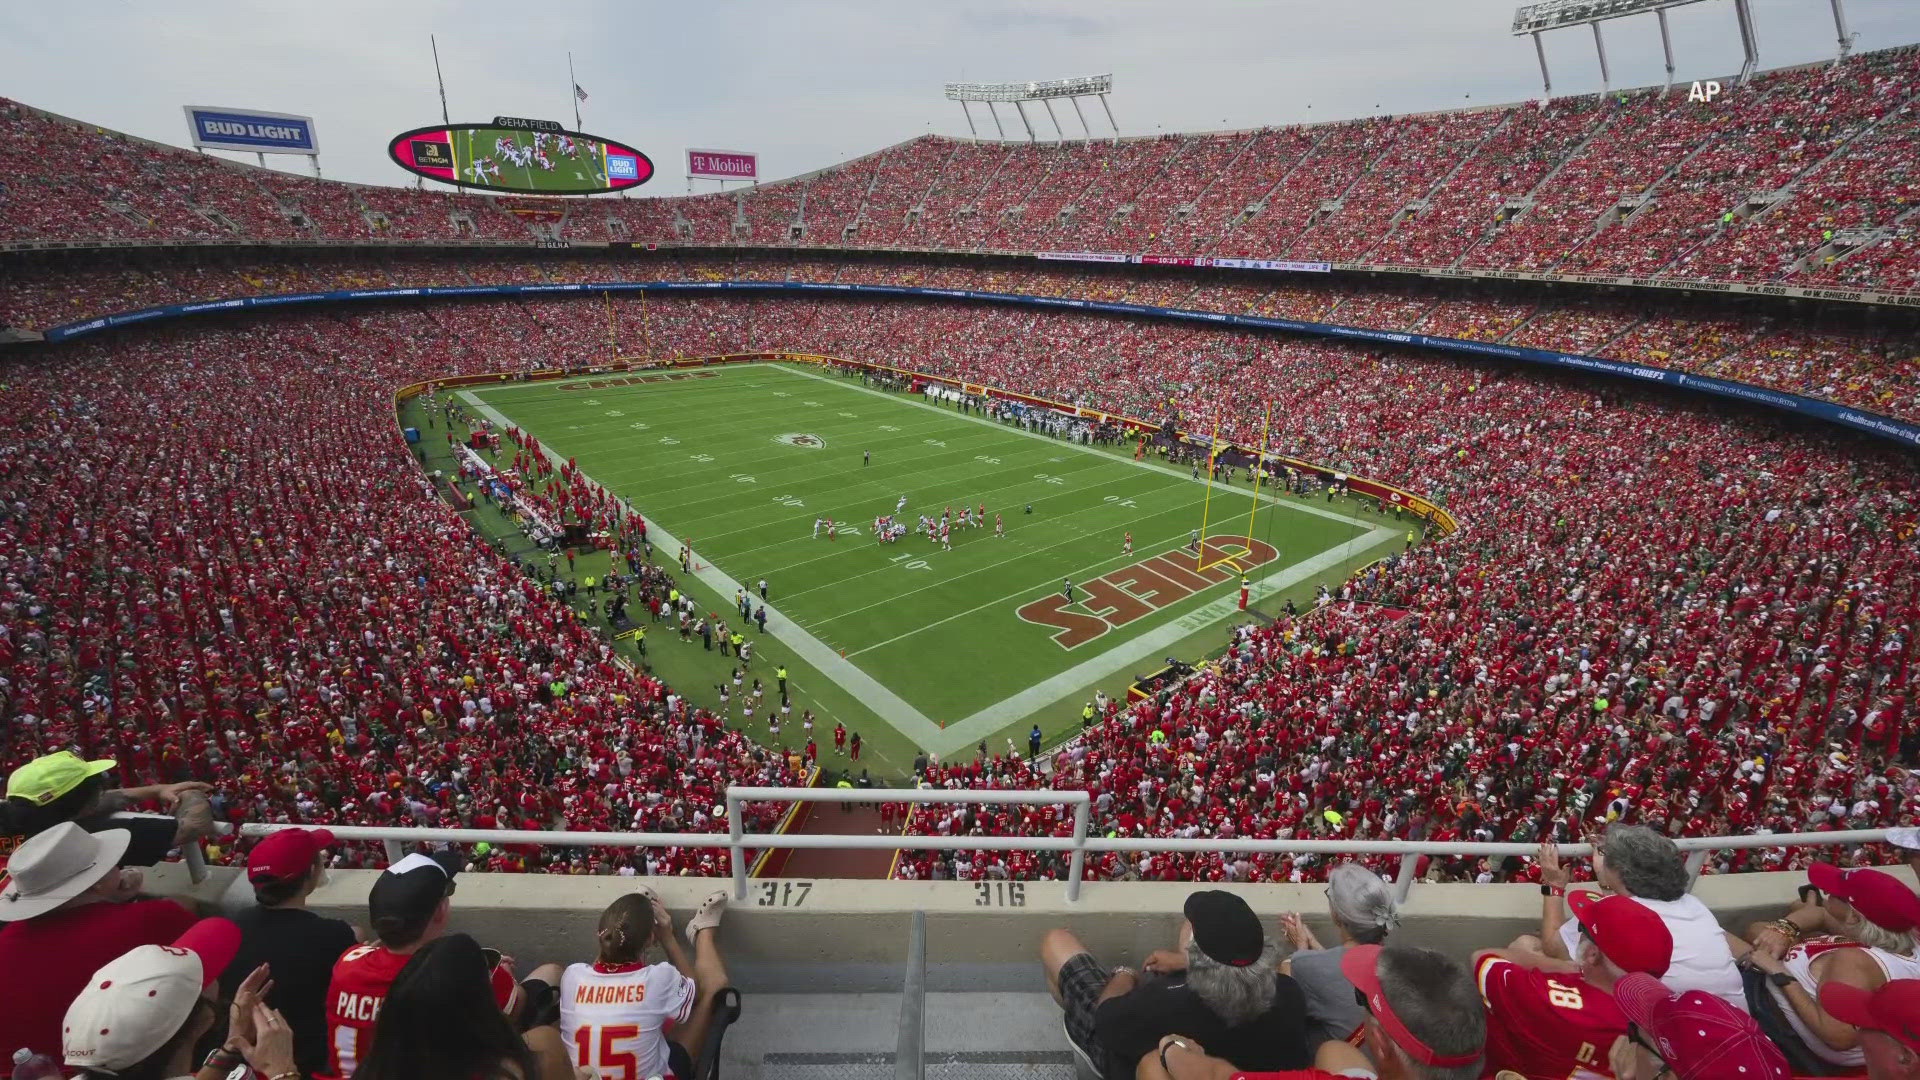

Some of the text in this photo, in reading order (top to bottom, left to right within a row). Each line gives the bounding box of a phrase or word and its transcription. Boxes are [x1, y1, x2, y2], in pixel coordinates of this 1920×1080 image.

[204, 121, 300, 140] BUD LIGHT
[498, 117, 558, 131] GEHA FIELD
[418, 156, 448, 164] BETMGM
[612, 159, 629, 167] BUD
[610, 165, 634, 174] LIGHT
[1632, 279, 1731, 291] MARTY SCHOTTENHEIMER
[1762, 286, 1787, 295] ROSS
[1823, 291, 1861, 300] SHIELDS
[1632, 368, 1666, 380] CHIEFS
[889, 553, 930, 571] 10
[758, 882, 813, 907] 317
[974, 882, 1026, 907] 316
[575, 984, 645, 1004] MAHOMES
[574, 1024, 640, 1080] 15
